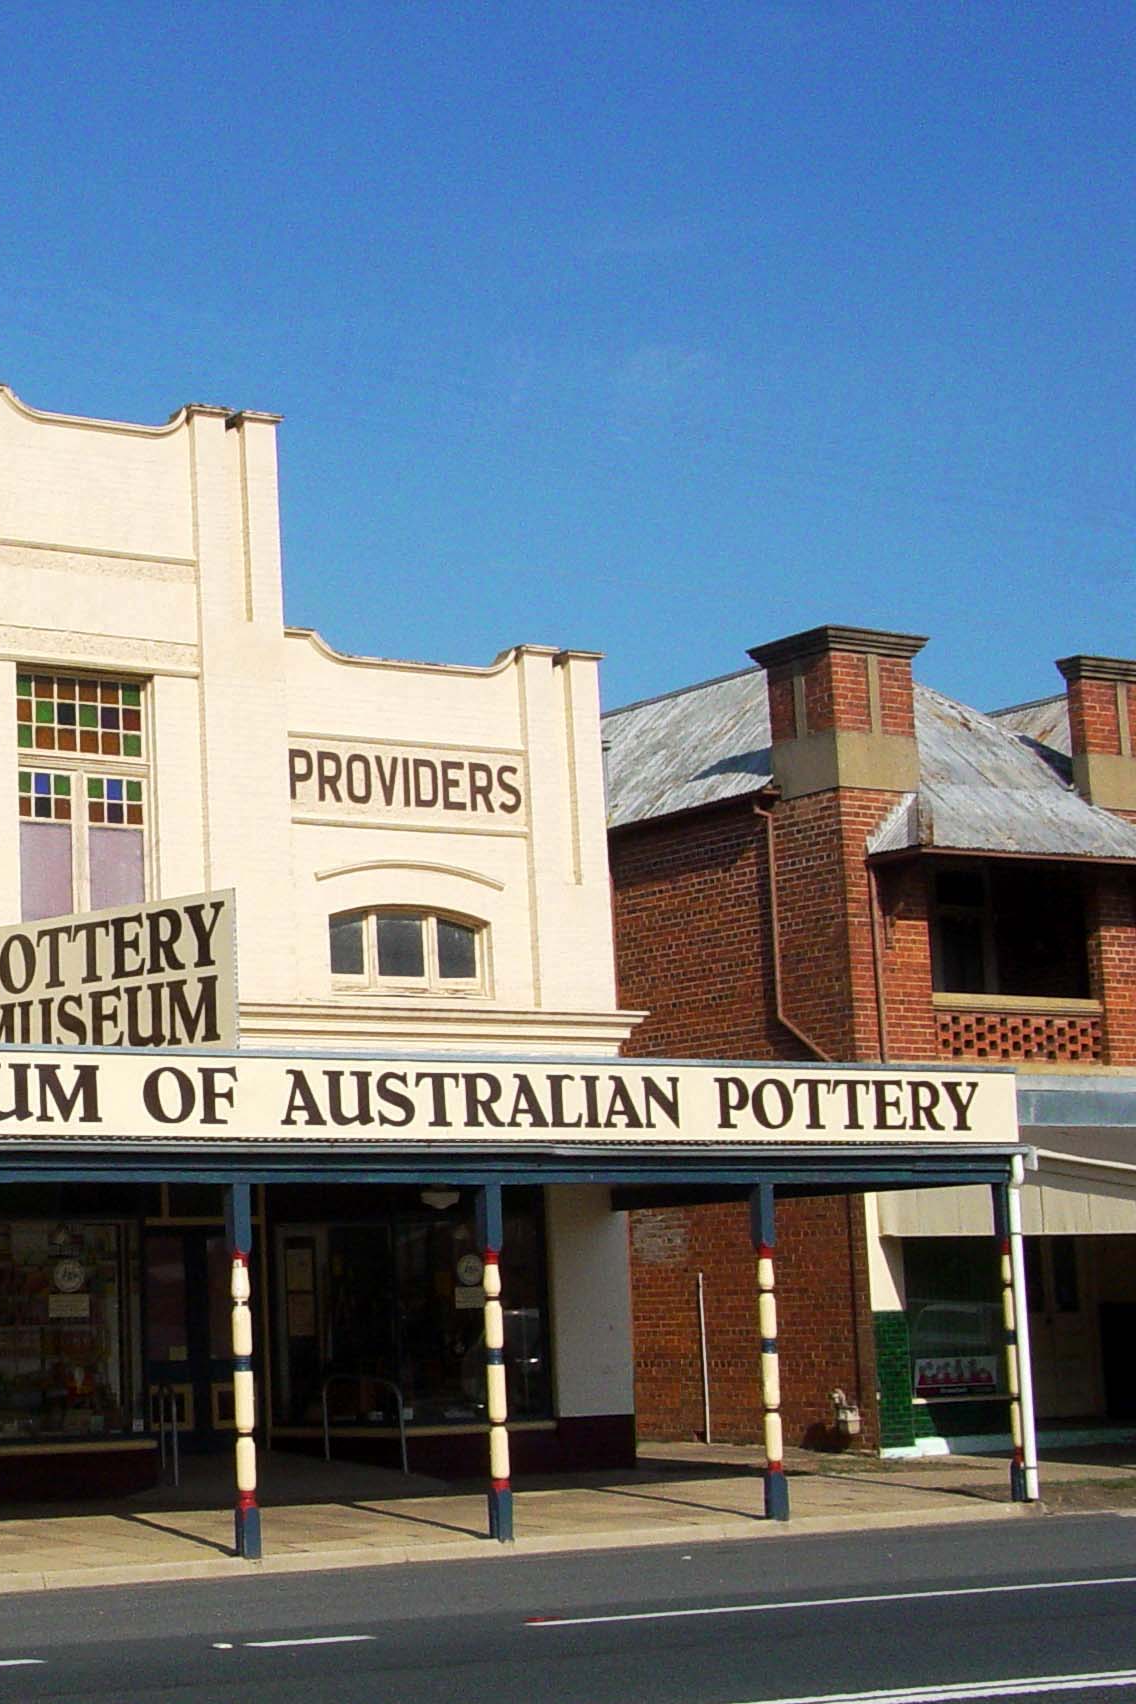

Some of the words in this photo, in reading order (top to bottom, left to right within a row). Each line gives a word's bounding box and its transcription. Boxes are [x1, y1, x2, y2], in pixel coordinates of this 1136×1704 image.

[287, 747, 522, 815] PROVIDERS
[142, 1065, 239, 1125] OF
[280, 1068, 681, 1129] AUSTRALIAN
[714, 1075, 980, 1132] POTTERY
